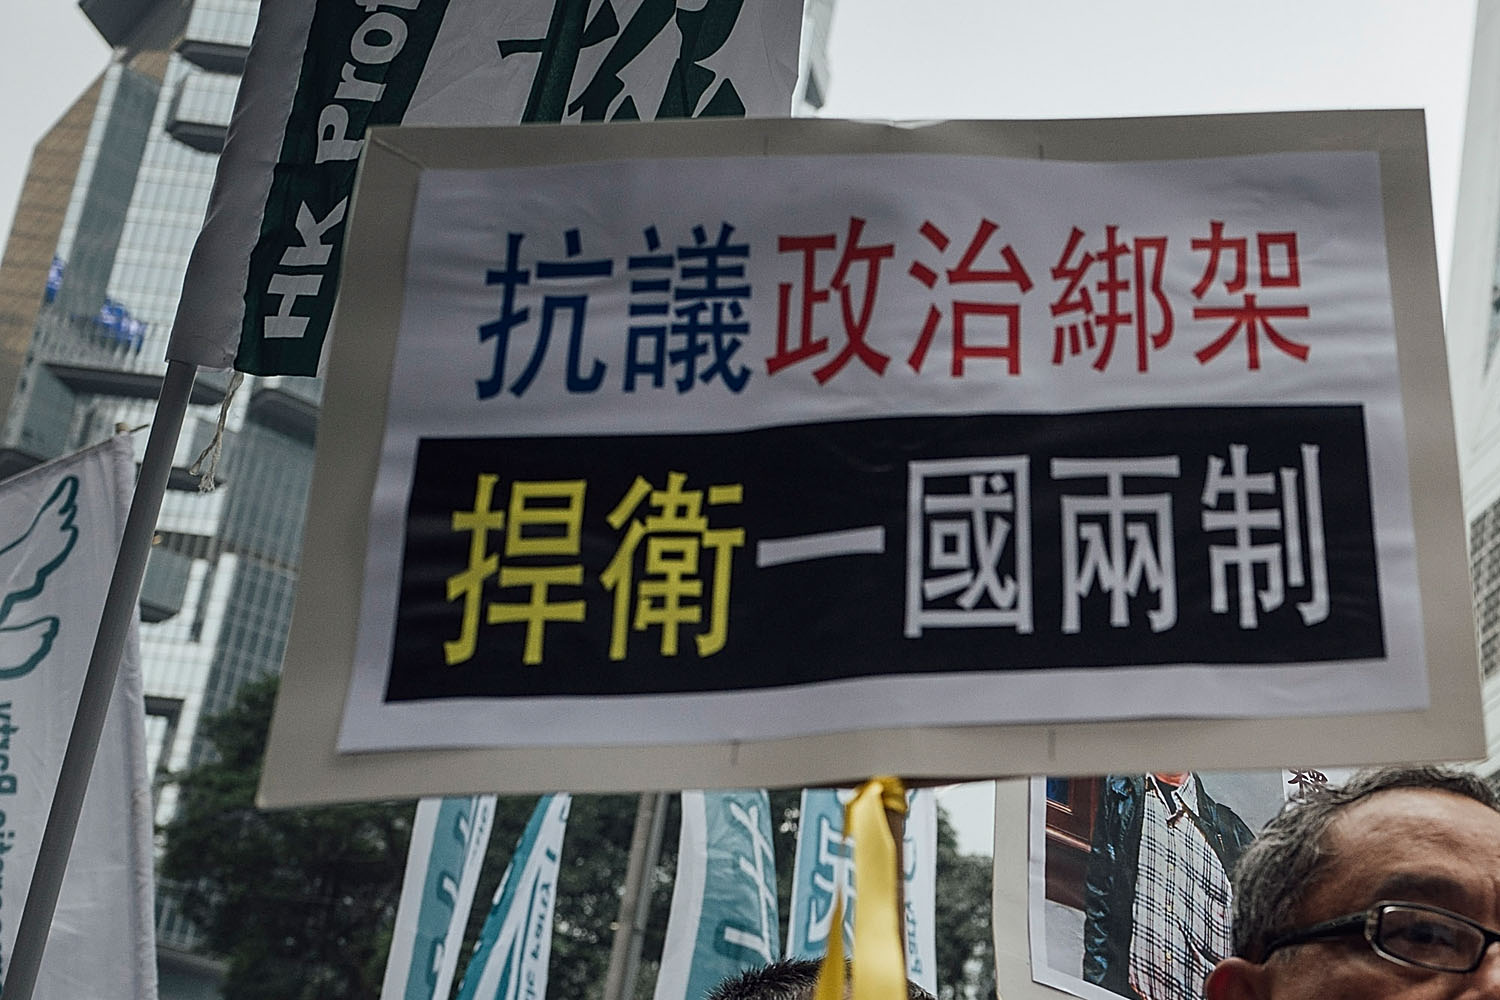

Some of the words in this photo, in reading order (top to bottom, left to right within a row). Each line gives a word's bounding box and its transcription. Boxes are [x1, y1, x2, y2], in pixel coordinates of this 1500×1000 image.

[264, 195, 349, 338] HK
[476, 216, 1311, 400] 抗議政治綁架
[443, 443, 1333, 665] 捍衛一國兩制
